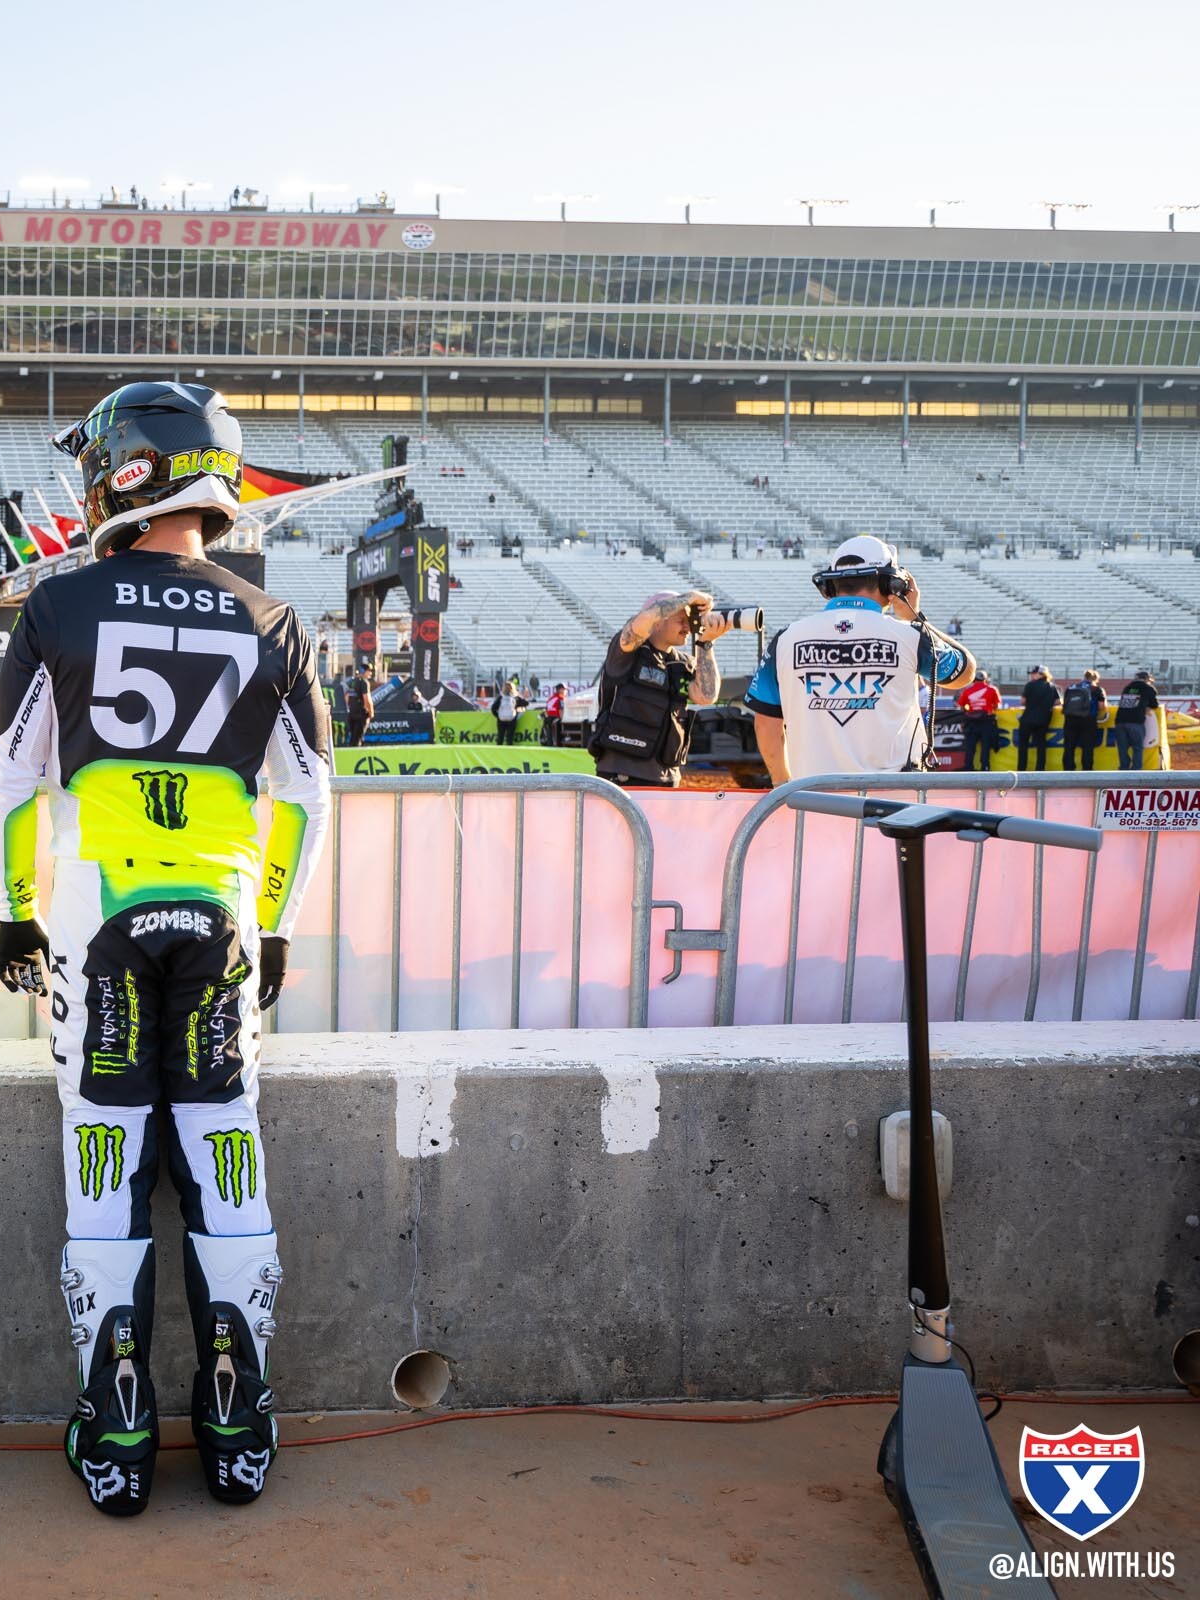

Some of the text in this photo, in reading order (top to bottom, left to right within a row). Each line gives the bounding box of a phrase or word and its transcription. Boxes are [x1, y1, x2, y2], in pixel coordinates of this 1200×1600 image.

[24, 216, 162, 246] MOTOR
[182, 218, 387, 249] SPEEDWAY
[116, 465, 147, 490] BELL
[169, 449, 240, 481] BLOSE
[356, 546, 388, 581] FINISH
[115, 582, 237, 616] BLOSE
[799, 642, 892, 664] Muc-Off
[89, 621, 259, 754] 57
[805, 671, 884, 695] FXR
[808, 697, 880, 710] CLUBMX
[8, 724, 24, 762] PRO
[281, 716, 313, 779] CIRCUIT
[459, 728, 539, 743] Kawaaki
[1119, 818, 1198, 826] 800-352-5675
[263, 861, 287, 904] FOX
[130, 909, 212, 938] ZOMBIE
[184, 1009, 200, 1080] CIRCUIT
[118, 1327, 132, 1341] 57
[215, 1323, 230, 1336] 57
[130, 1472, 140, 1499] FOX
[218, 1458, 229, 1487] FOX
